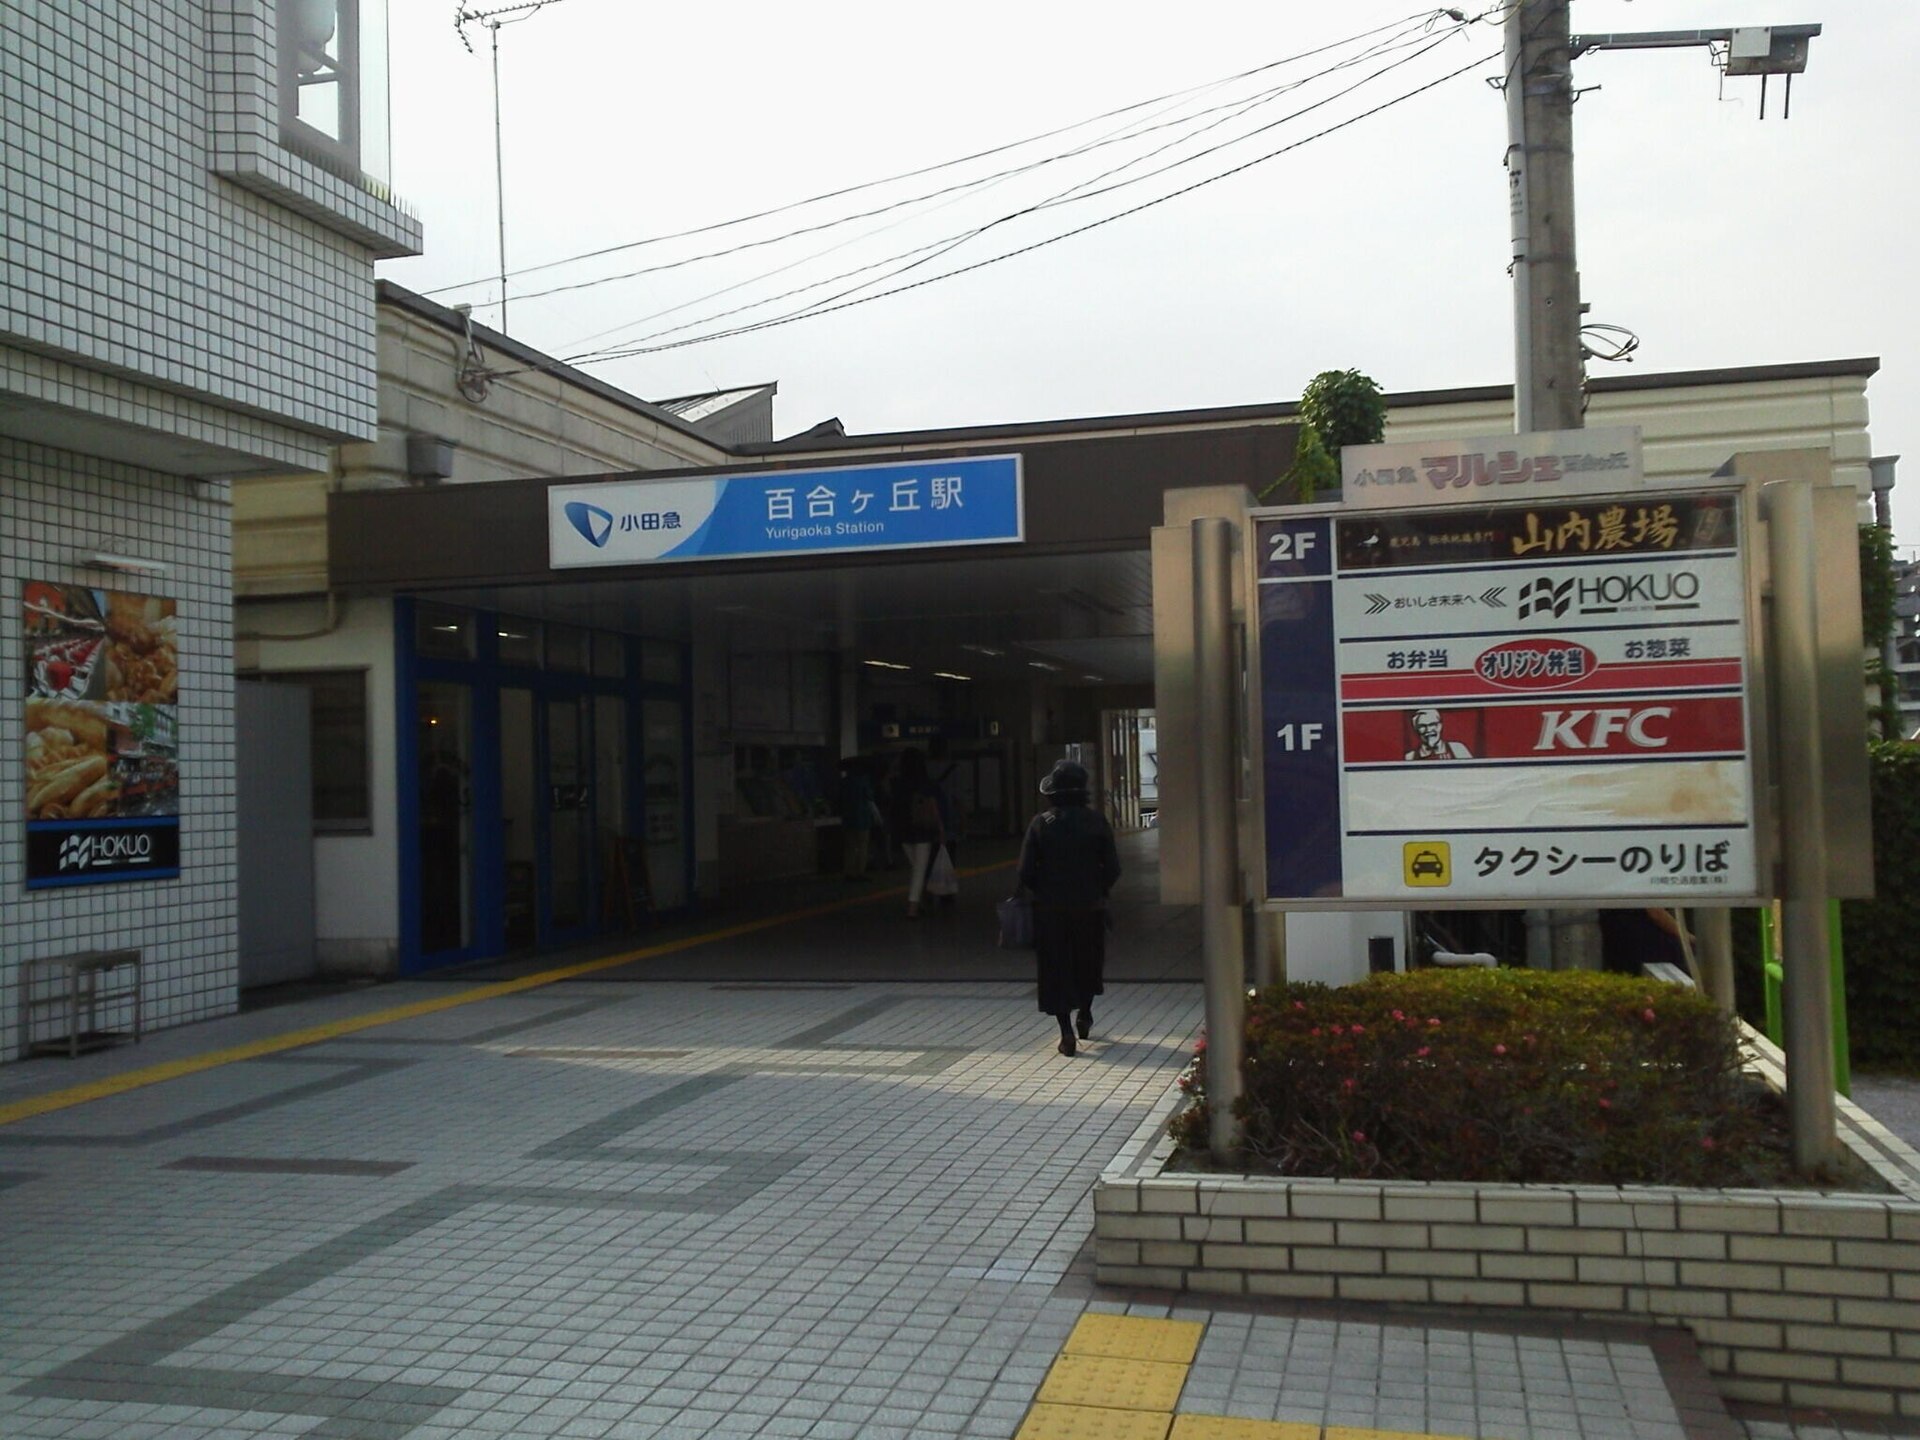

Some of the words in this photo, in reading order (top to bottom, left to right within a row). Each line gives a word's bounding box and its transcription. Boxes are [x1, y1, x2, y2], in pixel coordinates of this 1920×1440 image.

[1421, 450, 1562, 490] マルシェ
[620, 511, 682, 533] 小田急
[764, 523, 832, 541] Yurigaoka
[835, 519, 885, 536] Station
[1512, 504, 1680, 556] 山内農場
[1268, 531, 1317, 562] 2F
[1579, 571, 1700, 605] HOKUO
[1386, 649, 1449, 670] お弁当
[1480, 646, 1586, 679] オリジン弁当
[1625, 637, 1692, 660] お惣菜
[1276, 722, 1324, 752] 1F
[1533, 705, 1674, 751] KFC
[91, 834, 151, 858] HOKUO
[1473, 839, 1732, 877] タクシーのりば
